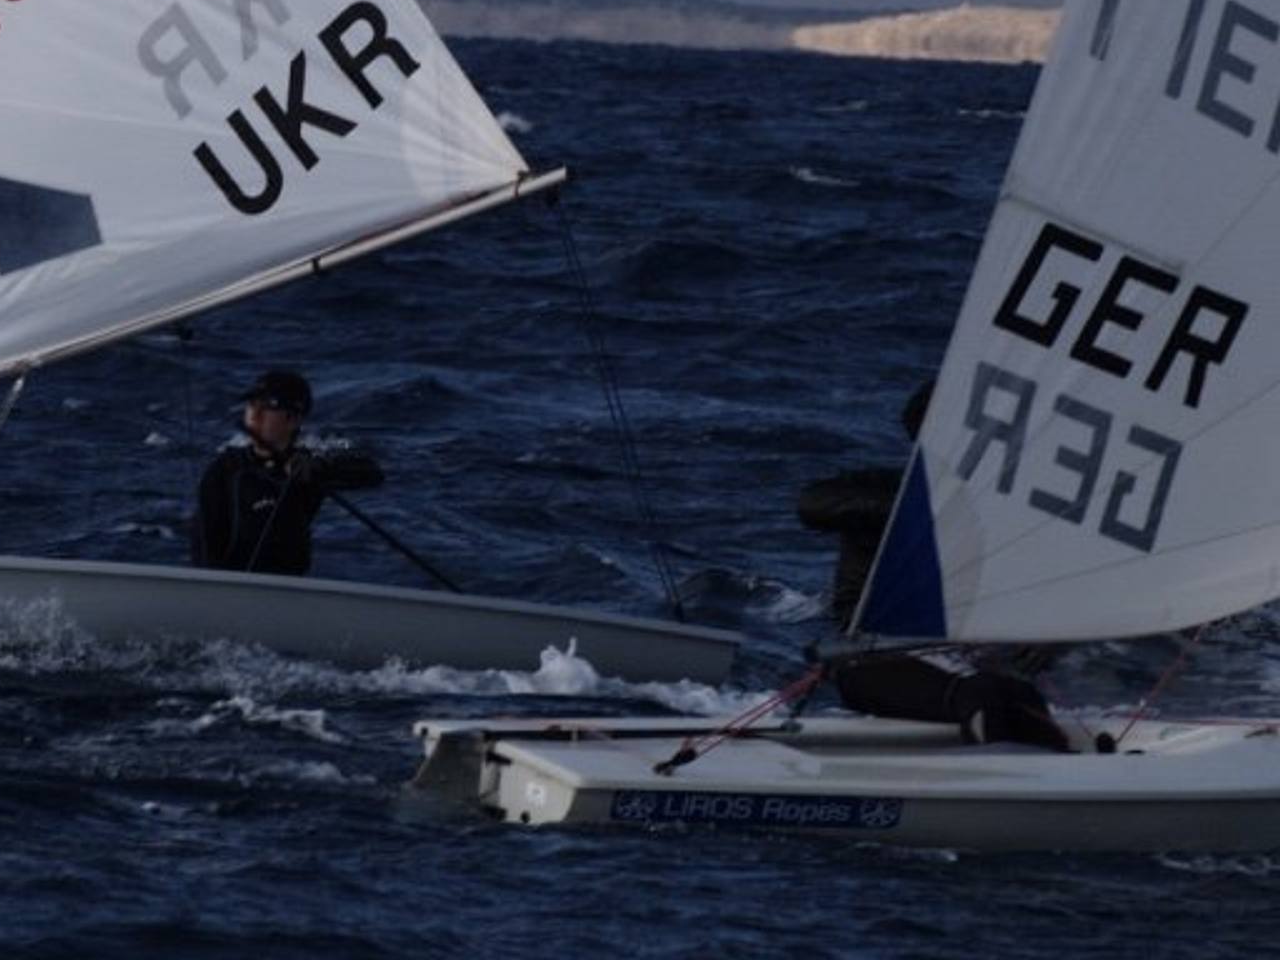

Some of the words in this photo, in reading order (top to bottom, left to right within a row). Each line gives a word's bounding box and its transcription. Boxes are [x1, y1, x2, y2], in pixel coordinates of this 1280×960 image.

[192, 0, 420, 216] UKR
[993, 221, 1249, 409] GER
[762, 798, 852, 823] Ropes
